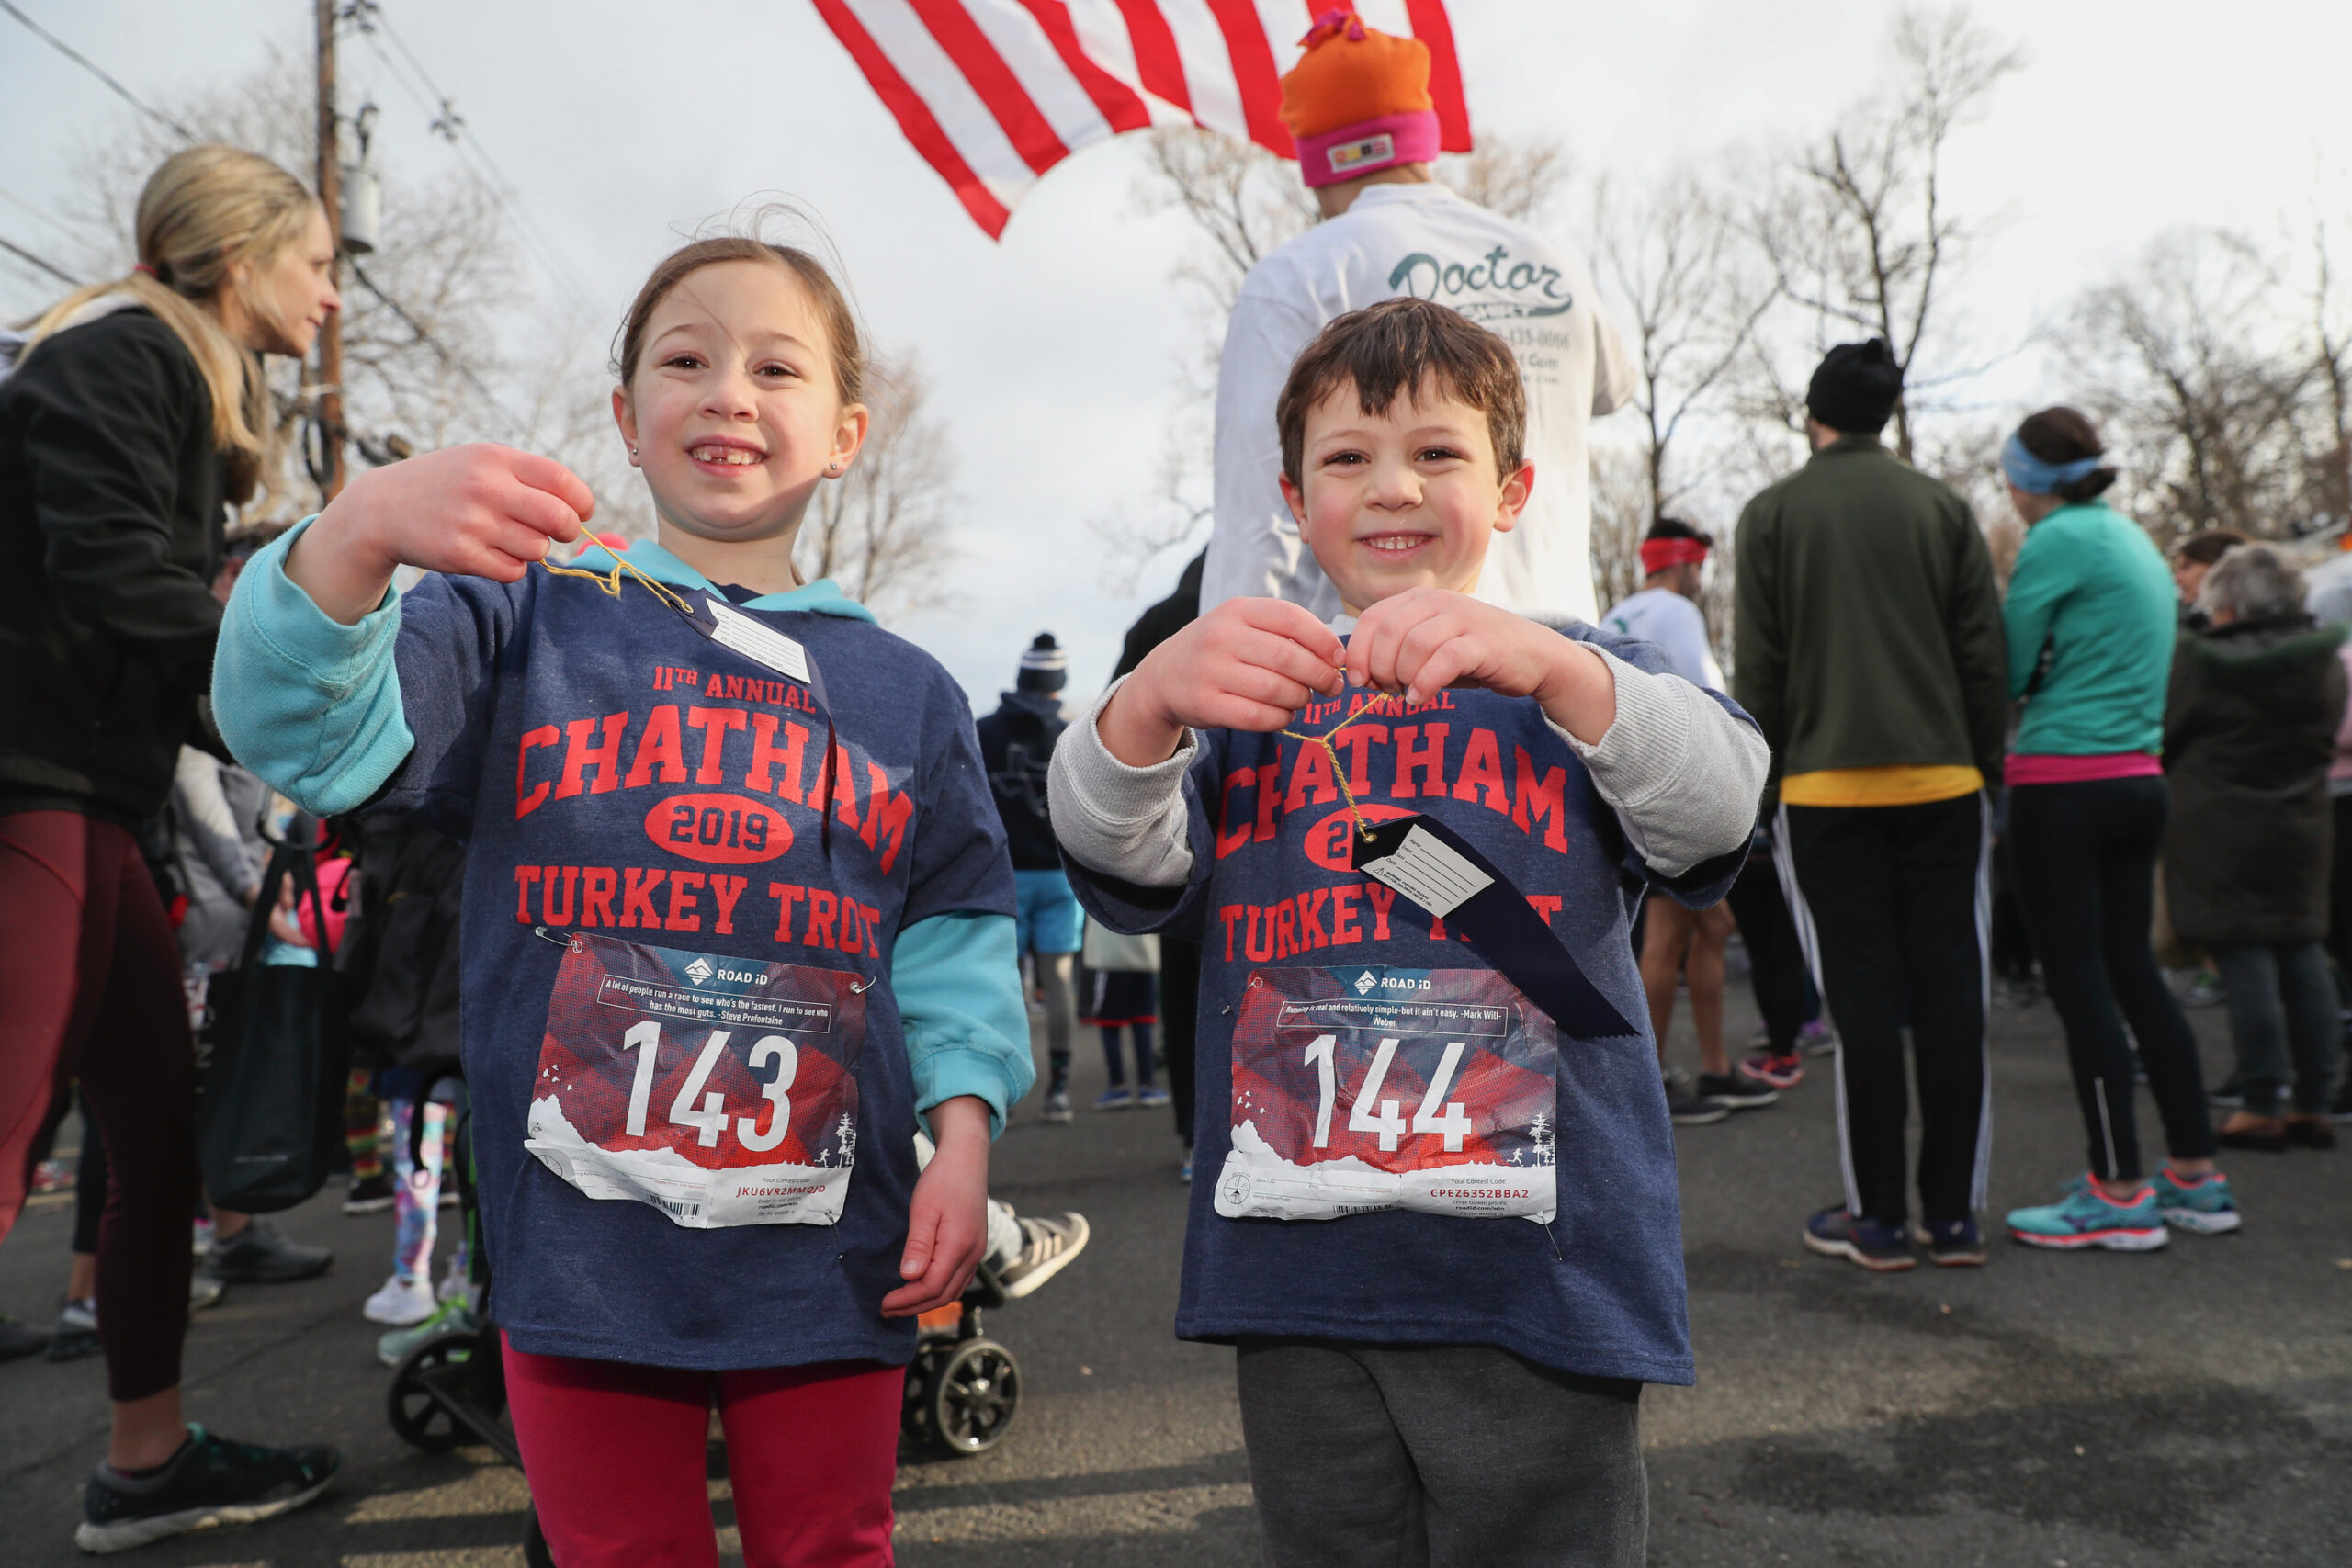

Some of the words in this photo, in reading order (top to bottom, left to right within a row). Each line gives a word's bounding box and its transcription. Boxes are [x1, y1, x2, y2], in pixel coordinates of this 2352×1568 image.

[1388, 244, 1572, 303] Doctor
[704, 674, 816, 714] ANNUAL
[515, 705, 913, 876] CHATHAM
[1216, 722, 1568, 860] CHATHAM
[669, 805, 769, 852] 2019
[514, 865, 748, 934] TURKEY
[768, 882, 881, 958] TROT
[1219, 881, 1396, 963] TURKEY
[718, 969, 752, 983] ROAD
[1381, 977, 1415, 989] ROAD
[605, 979, 612, 988] A
[612, 980, 620, 989] lot
[621, 982, 628, 992] of
[629, 985, 653, 996] people
[654, 990, 667, 998] run
[673, 993, 690, 1001] race
[692, 994, 699, 1003] to
[701, 997, 714, 1005] see
[716, 997, 736, 1008] who's
[738, 999, 750, 1010] the
[751, 1001, 776, 1012] fastest.
[783, 1006, 795, 1014] run
[796, 1007, 803, 1015] to
[804, 1008, 815, 1016] see
[817, 1008, 828, 1017] who
[650, 1000, 662, 1010] has
[664, 1001, 676, 1012] the
[677, 1004, 695, 1015] most
[697, 1007, 716, 1019] guts.
[718, 1011, 741, 1021] -Steve
[742, 1013, 783, 1025] Prefontaine
[1286, 1005, 1309, 1014] Running
[1316, 1003, 1328, 1011] real
[1329, 1003, 1340, 1011] and
[1340, 1003, 1374, 1014] relatively
[1415, 1006, 1421, 1016] it
[1422, 1007, 1439, 1017] ain't
[1440, 1010, 1459, 1020] easy.
[1461, 1010, 1482, 1020] -Mark
[1484, 1010, 1501, 1021] Will-
[1373, 1016, 1396, 1027] Weber
[624, 1020, 797, 1152] 143
[1304, 1034, 1472, 1152] 144
[1430, 1189, 1529, 1199] CPEZ6352BBA2
